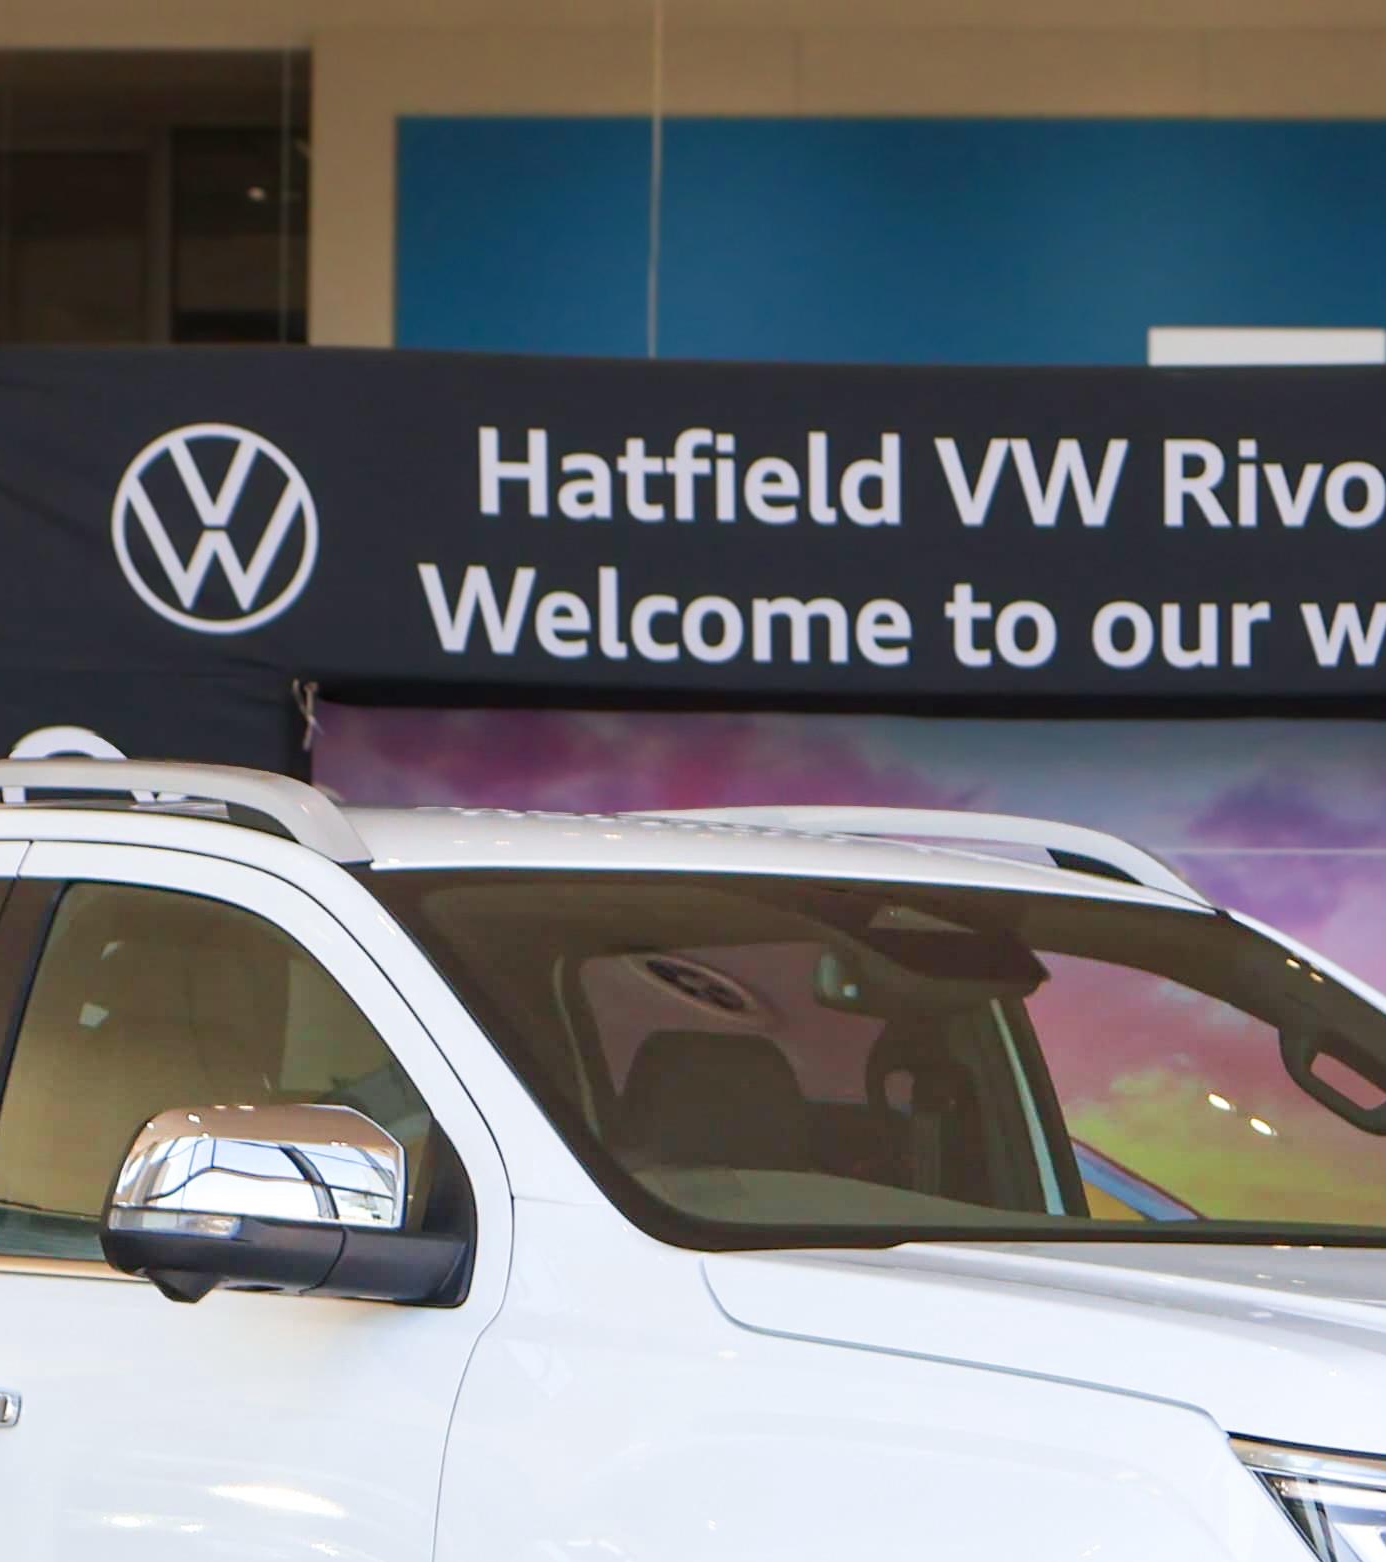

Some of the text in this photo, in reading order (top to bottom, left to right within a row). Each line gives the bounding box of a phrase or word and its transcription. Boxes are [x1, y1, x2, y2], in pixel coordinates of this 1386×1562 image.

[478, 426, 901, 526] Hatfield
[934, 437, 1129, 527] VW
[417, 563, 912, 666] Welcome
[944, 583, 1057, 668] to
[1092, 601, 1271, 668] our
